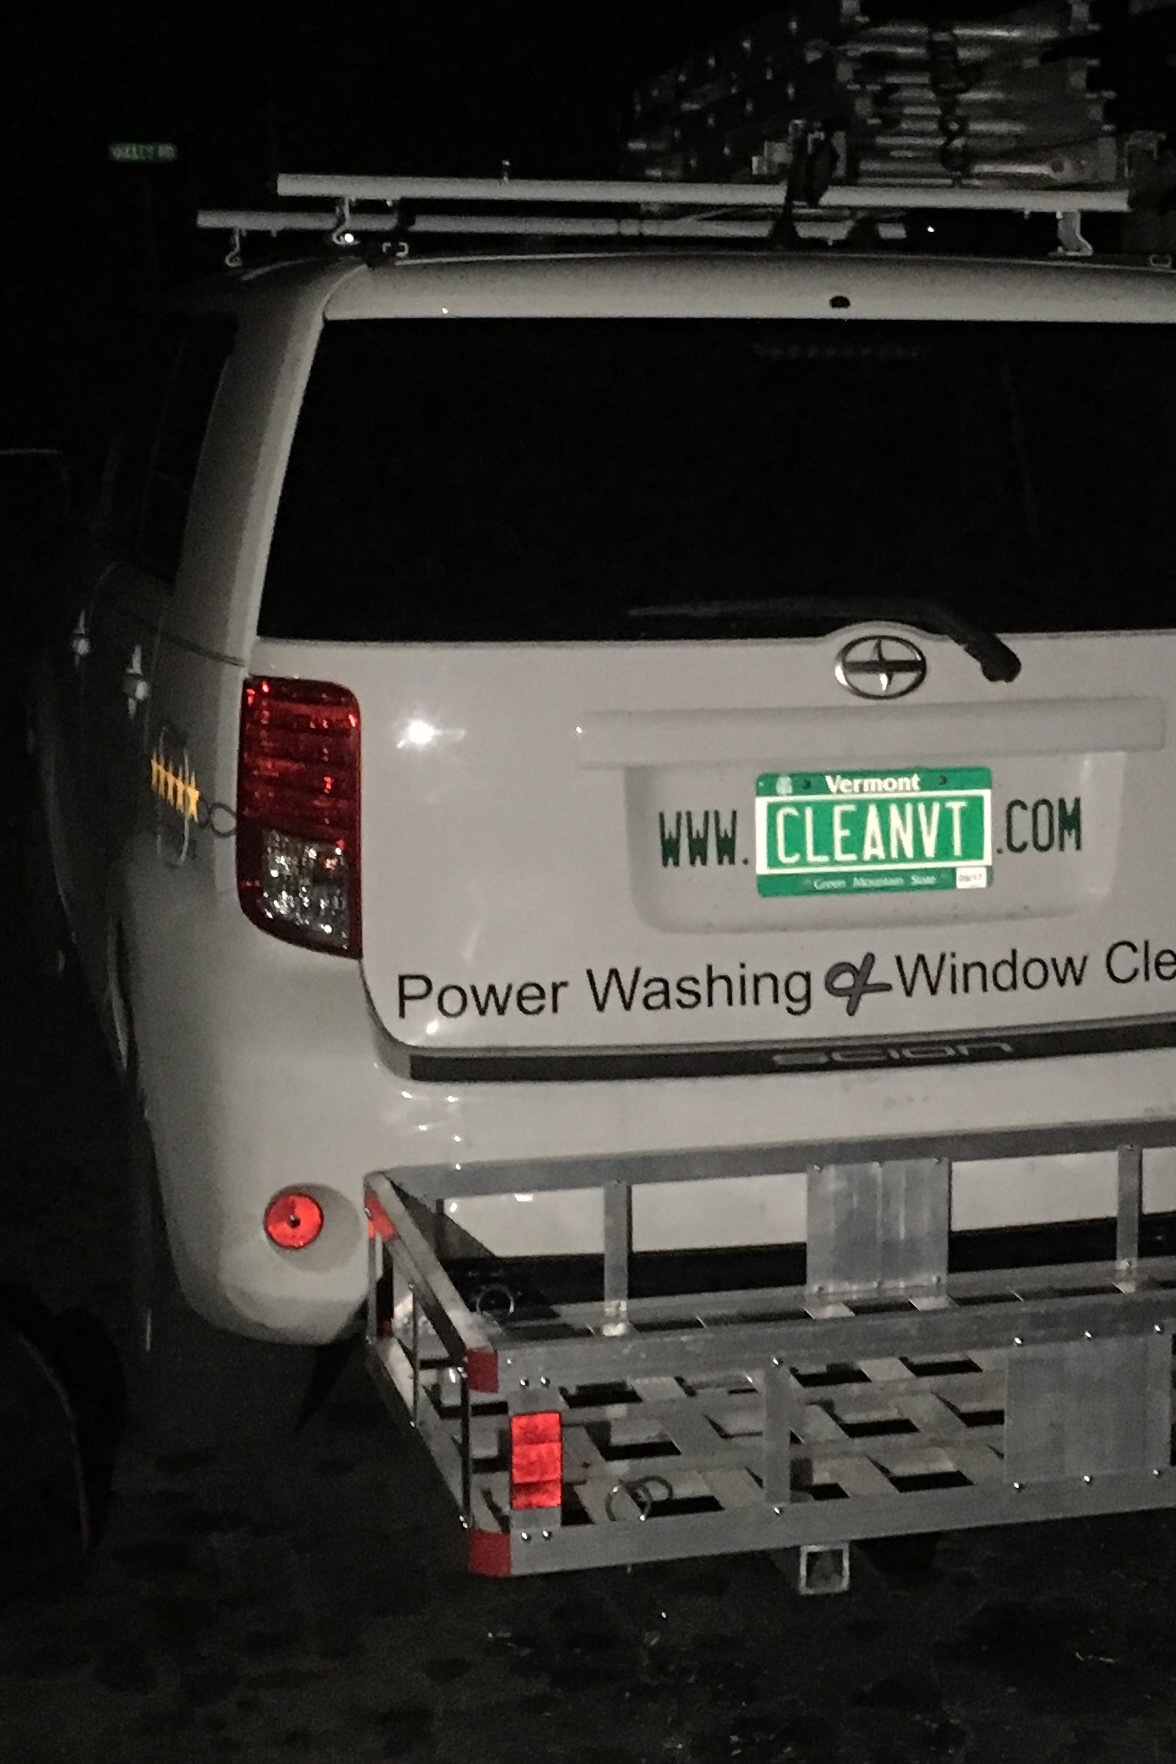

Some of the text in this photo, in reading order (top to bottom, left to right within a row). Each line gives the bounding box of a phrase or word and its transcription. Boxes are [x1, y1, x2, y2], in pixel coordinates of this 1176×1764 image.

[825, 773, 921, 794] Vermont
[658, 797, 1082, 868] WWW. CLEANVT .COM
[397, 973, 569, 1019] Power
[585, 962, 812, 1017] Washing
[895, 948, 1088, 998] Window
